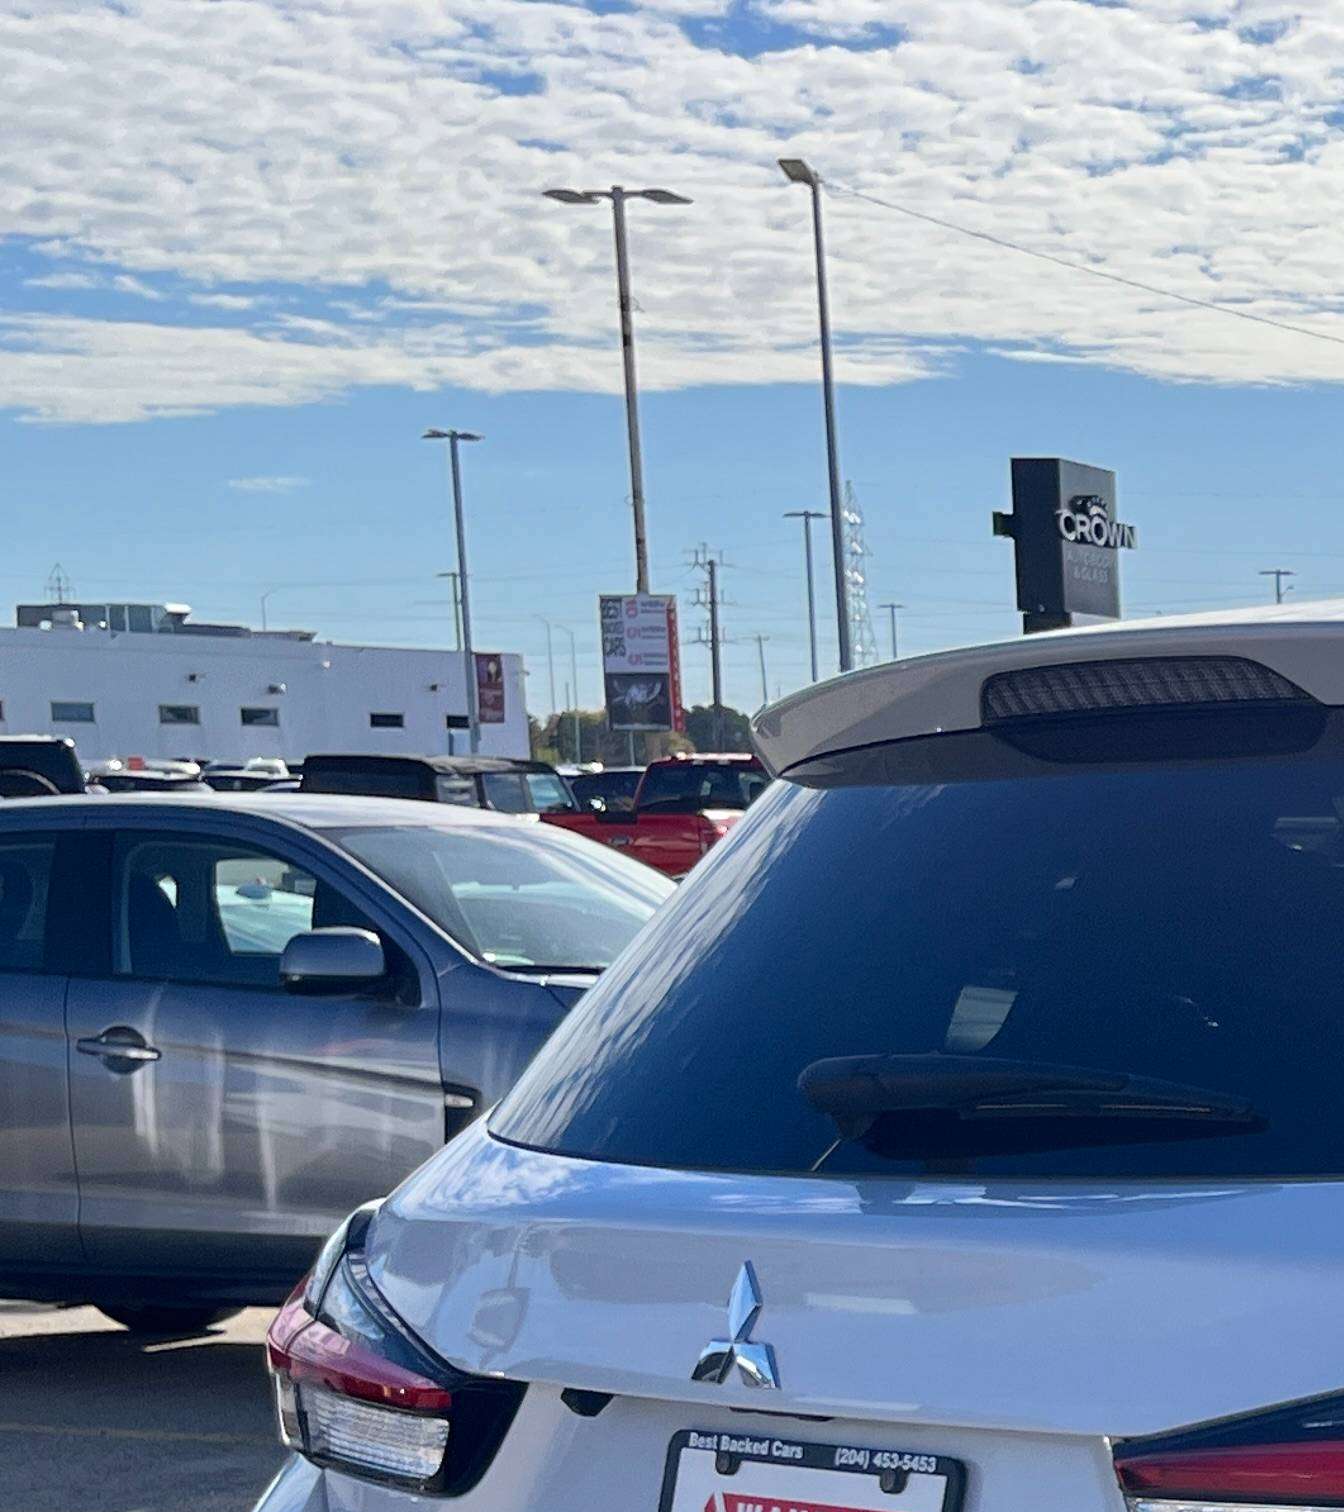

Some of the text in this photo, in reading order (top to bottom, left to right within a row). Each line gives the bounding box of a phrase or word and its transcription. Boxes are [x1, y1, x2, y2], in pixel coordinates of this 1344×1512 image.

[1055, 508, 1138, 549] CROWN
[688, 1431, 937, 1473] Best Backed Cars (204) 453-5453
